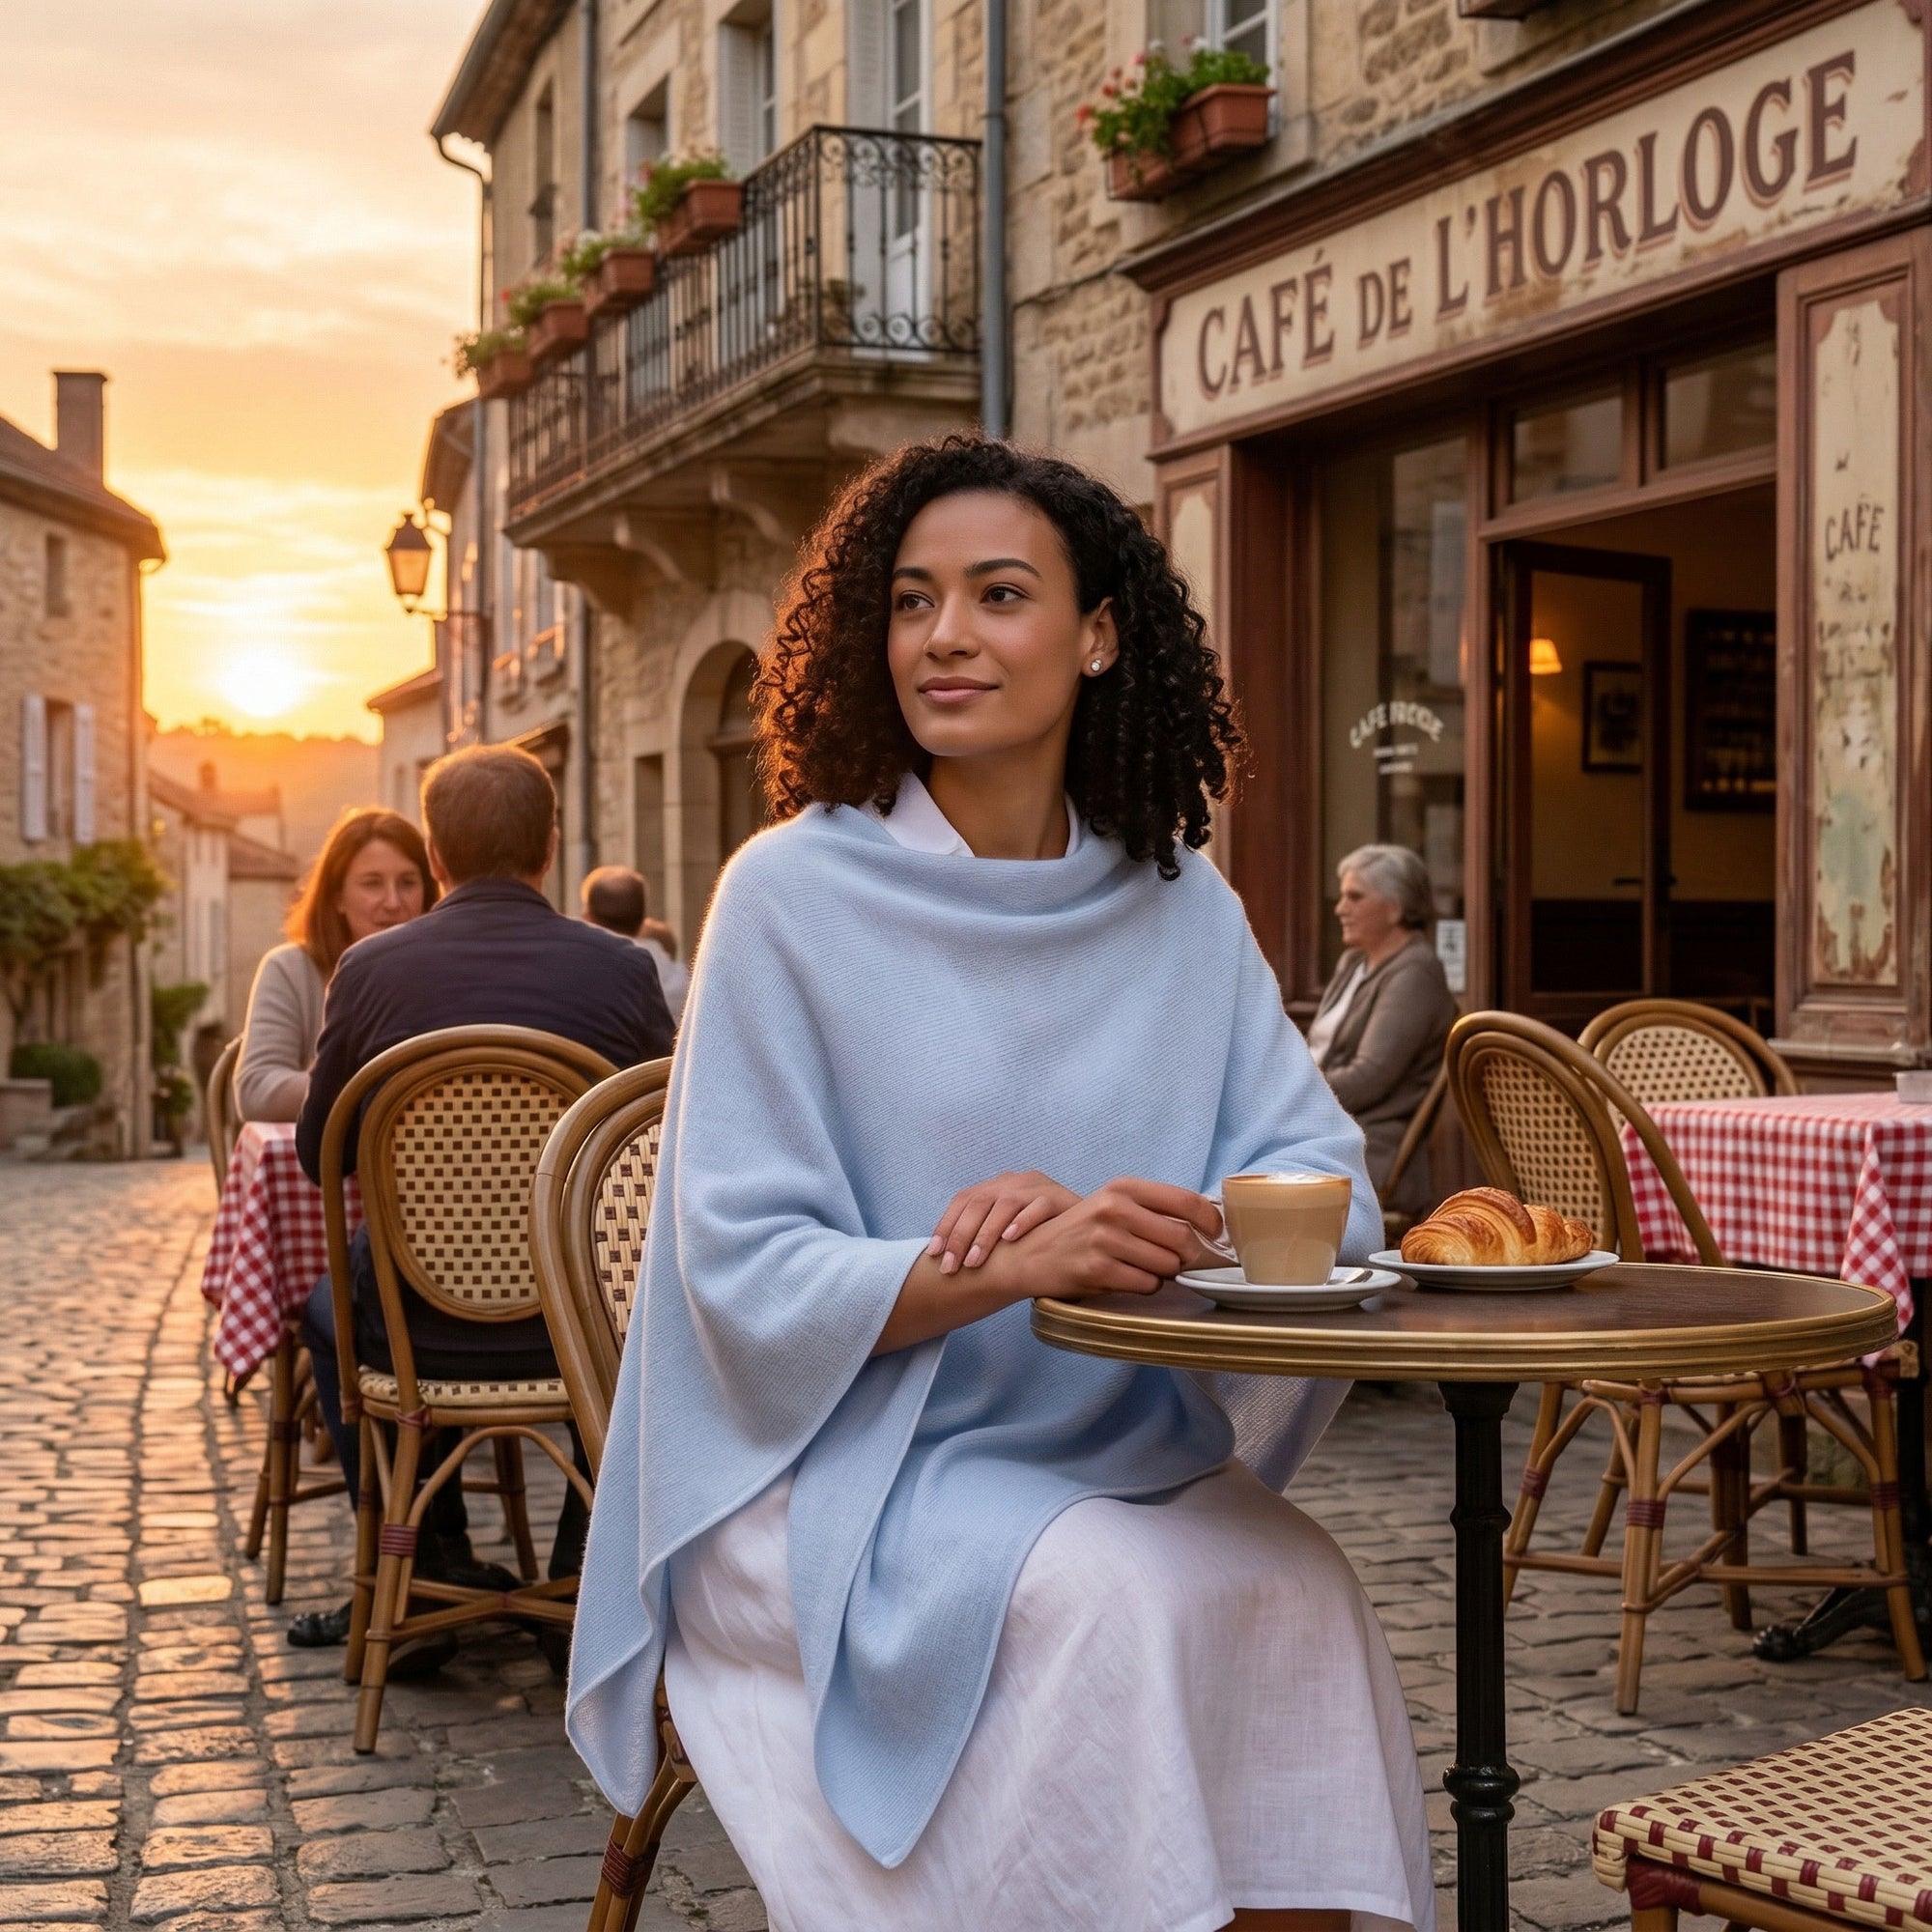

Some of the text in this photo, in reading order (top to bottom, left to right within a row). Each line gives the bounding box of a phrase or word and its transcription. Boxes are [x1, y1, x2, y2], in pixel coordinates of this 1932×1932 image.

[1198, 50, 1858, 399] CAFÉ DE L'HORLOGE
